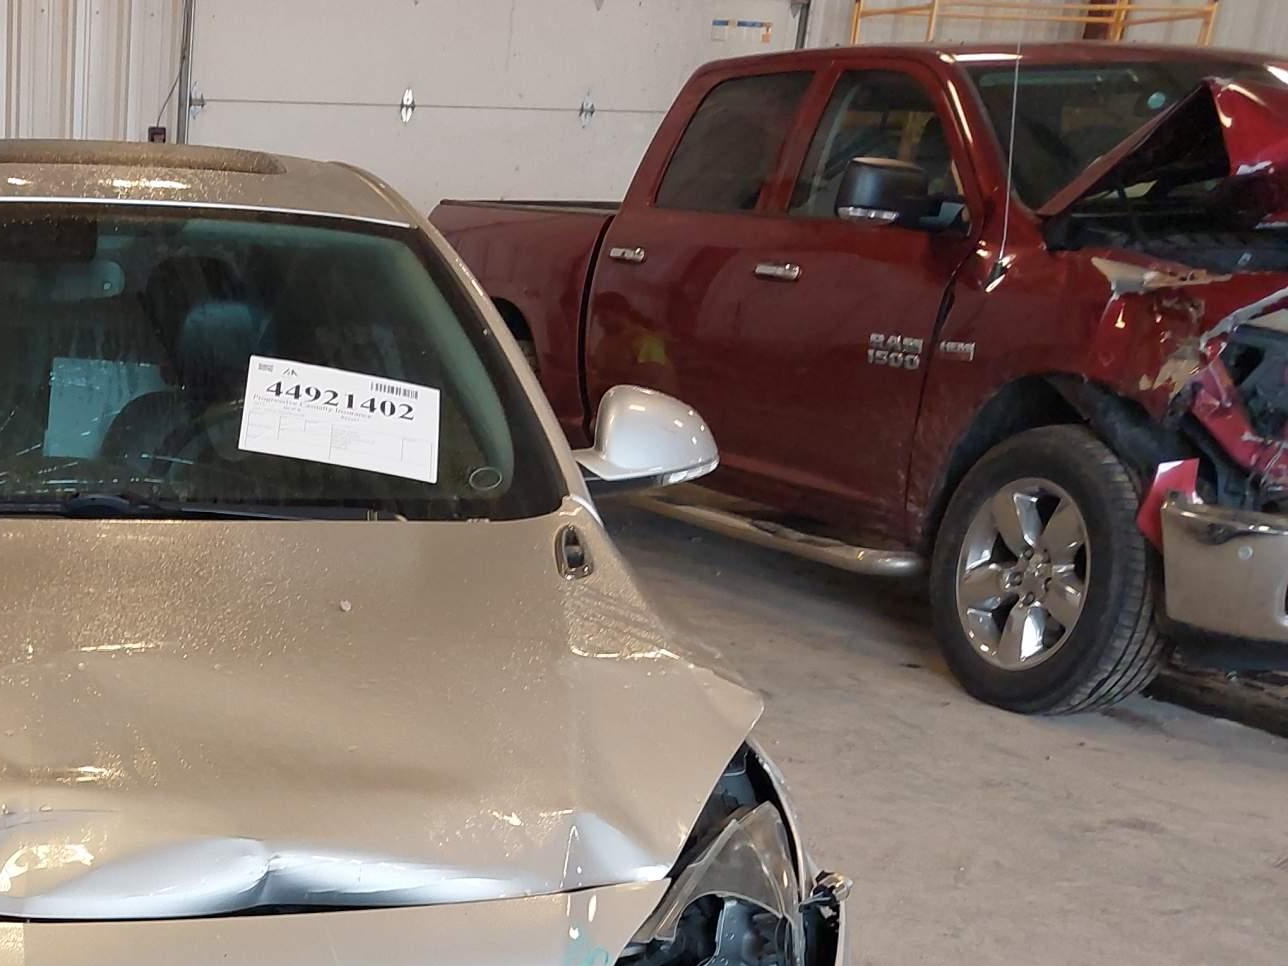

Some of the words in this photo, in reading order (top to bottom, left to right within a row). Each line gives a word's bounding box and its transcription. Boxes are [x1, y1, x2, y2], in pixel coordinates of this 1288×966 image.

[869, 333, 924, 353] RAM
[867, 349, 921, 370] 1500
[265, 380, 415, 421] 44921402
